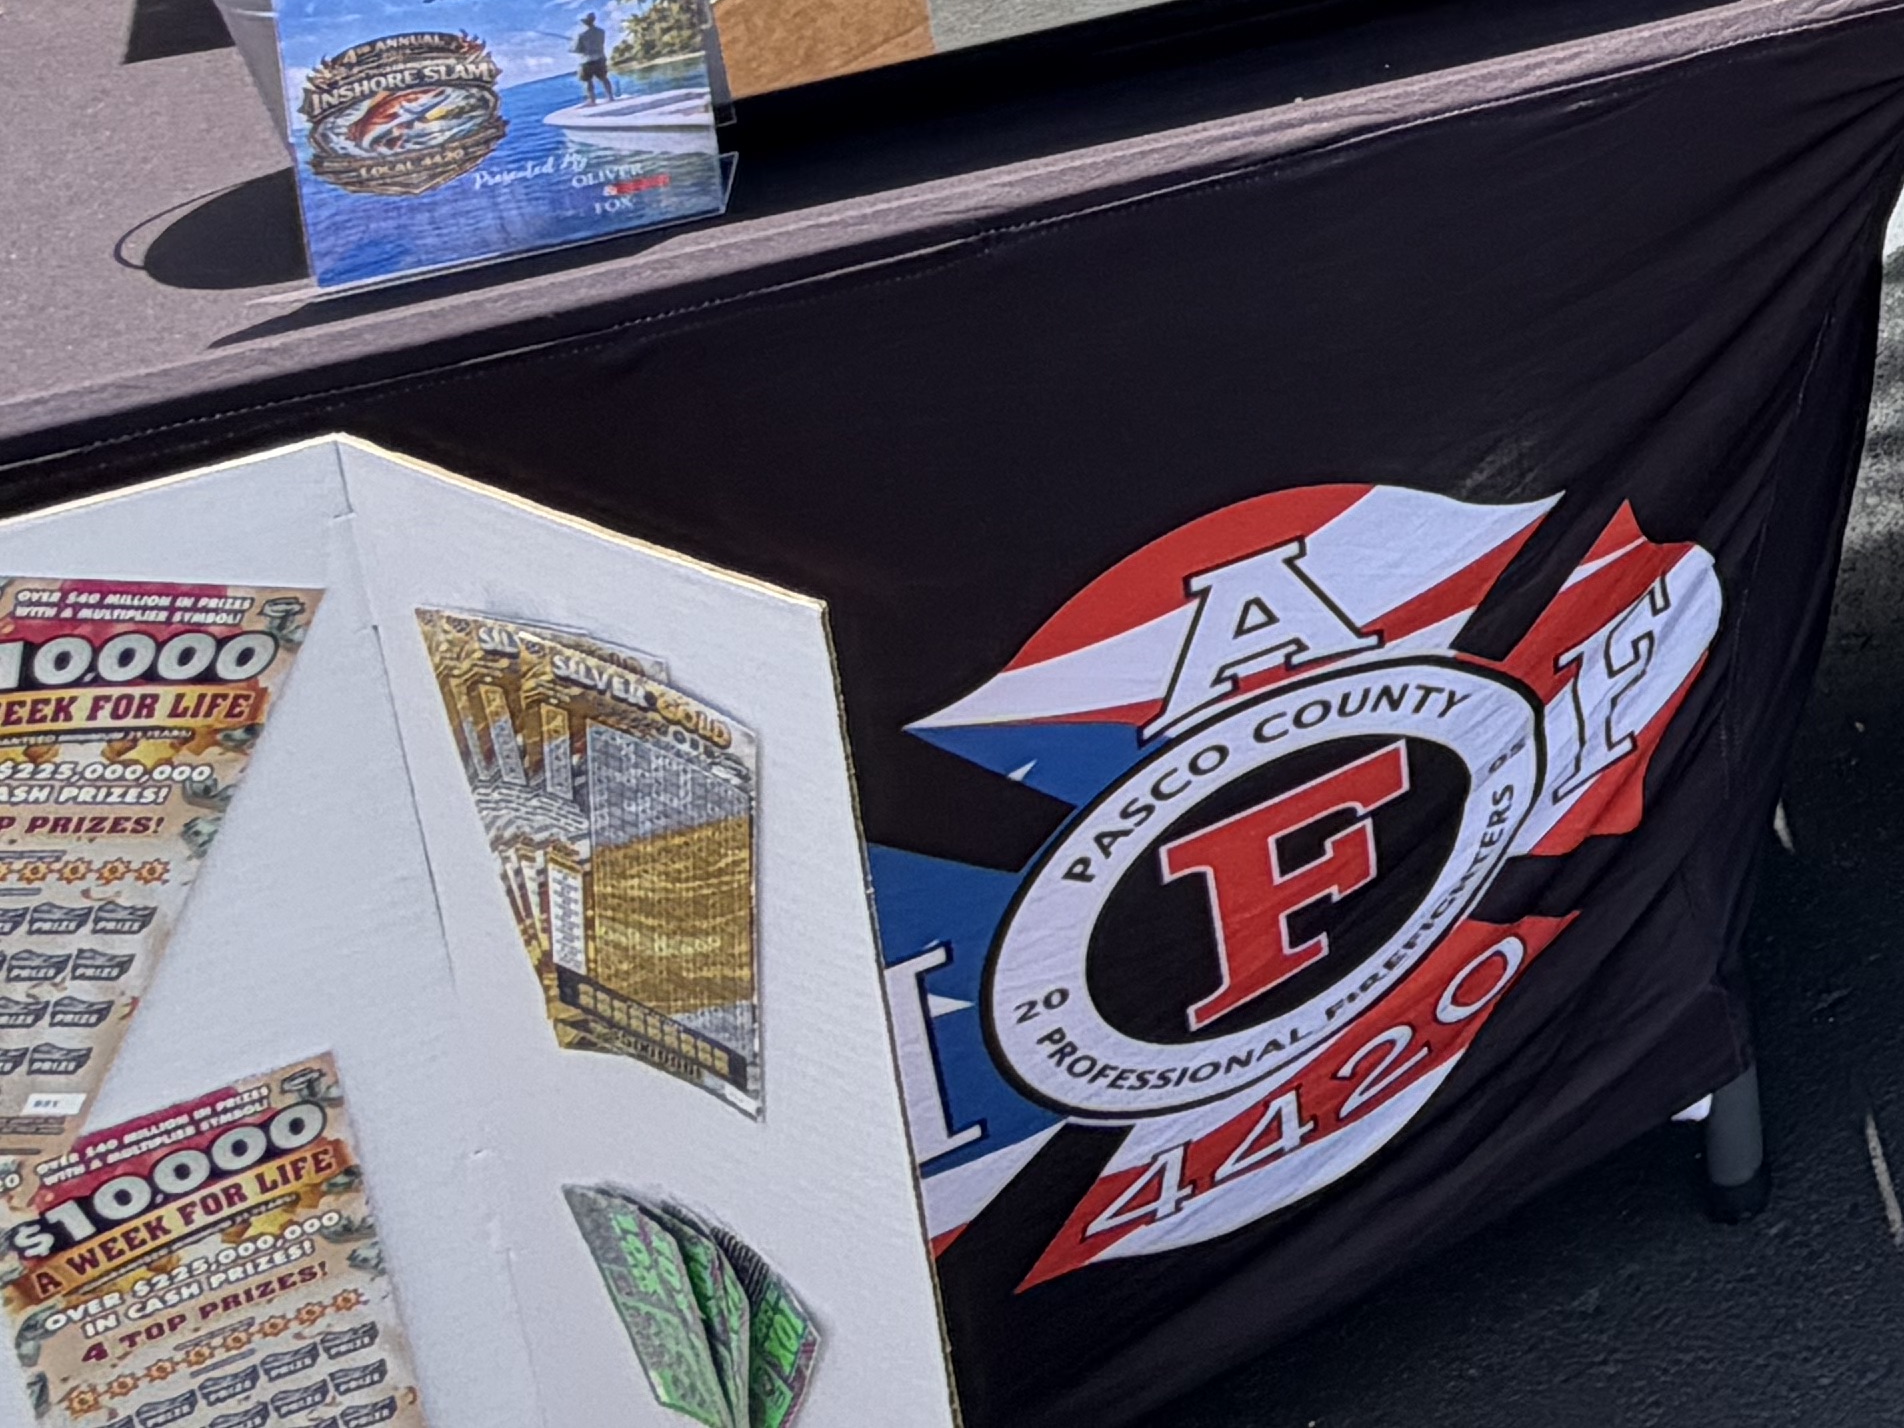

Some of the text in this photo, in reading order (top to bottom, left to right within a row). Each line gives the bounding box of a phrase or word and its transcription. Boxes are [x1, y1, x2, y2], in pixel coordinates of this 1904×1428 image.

[310, 60, 492, 112] INSHORE SLAM
[373, 32, 445, 53] ANNUAL
[14, 605, 57, 619] WITH
[61, 607, 73, 619] A
[76, 607, 170, 623] MULTIPLIER
[16, 589, 62, 604] OVER
[103, 593, 171, 608] MILLION
[175, 595, 192, 608] IN
[197, 596, 252, 611] PRIZES
[1137, 534, 1385, 744] A
[85, 692, 252, 722] FOR LIFE
[550, 653, 733, 750] SILVER GOLD
[24, 815, 166, 835] PRIZES!
[56, 785, 170, 805] PRIZES!
[1061, 681, 1472, 886] PASCO COUNTY
[1160, 738, 1412, 1033] F
[1035, 781, 1515, 1094] PROFESSIONAL FIREFIGHTERS
[1012, 986, 1071, 1026] 20
[122, 1114, 191, 1145] MILLION
[215, 1085, 271, 1115] PRIZES
[1081, 934, 1527, 1244] 4420
[13, 1099, 327, 1259] $10,000
[34, 1146, 338, 1299] A WEEK FOR LIFE
[44, 1210, 342, 1334] OVER $225,000,000
[81, 1239, 317, 1340] IN CASH PRIZES!
[81, 1259, 331, 1364] 4 TOP PRIZES!
